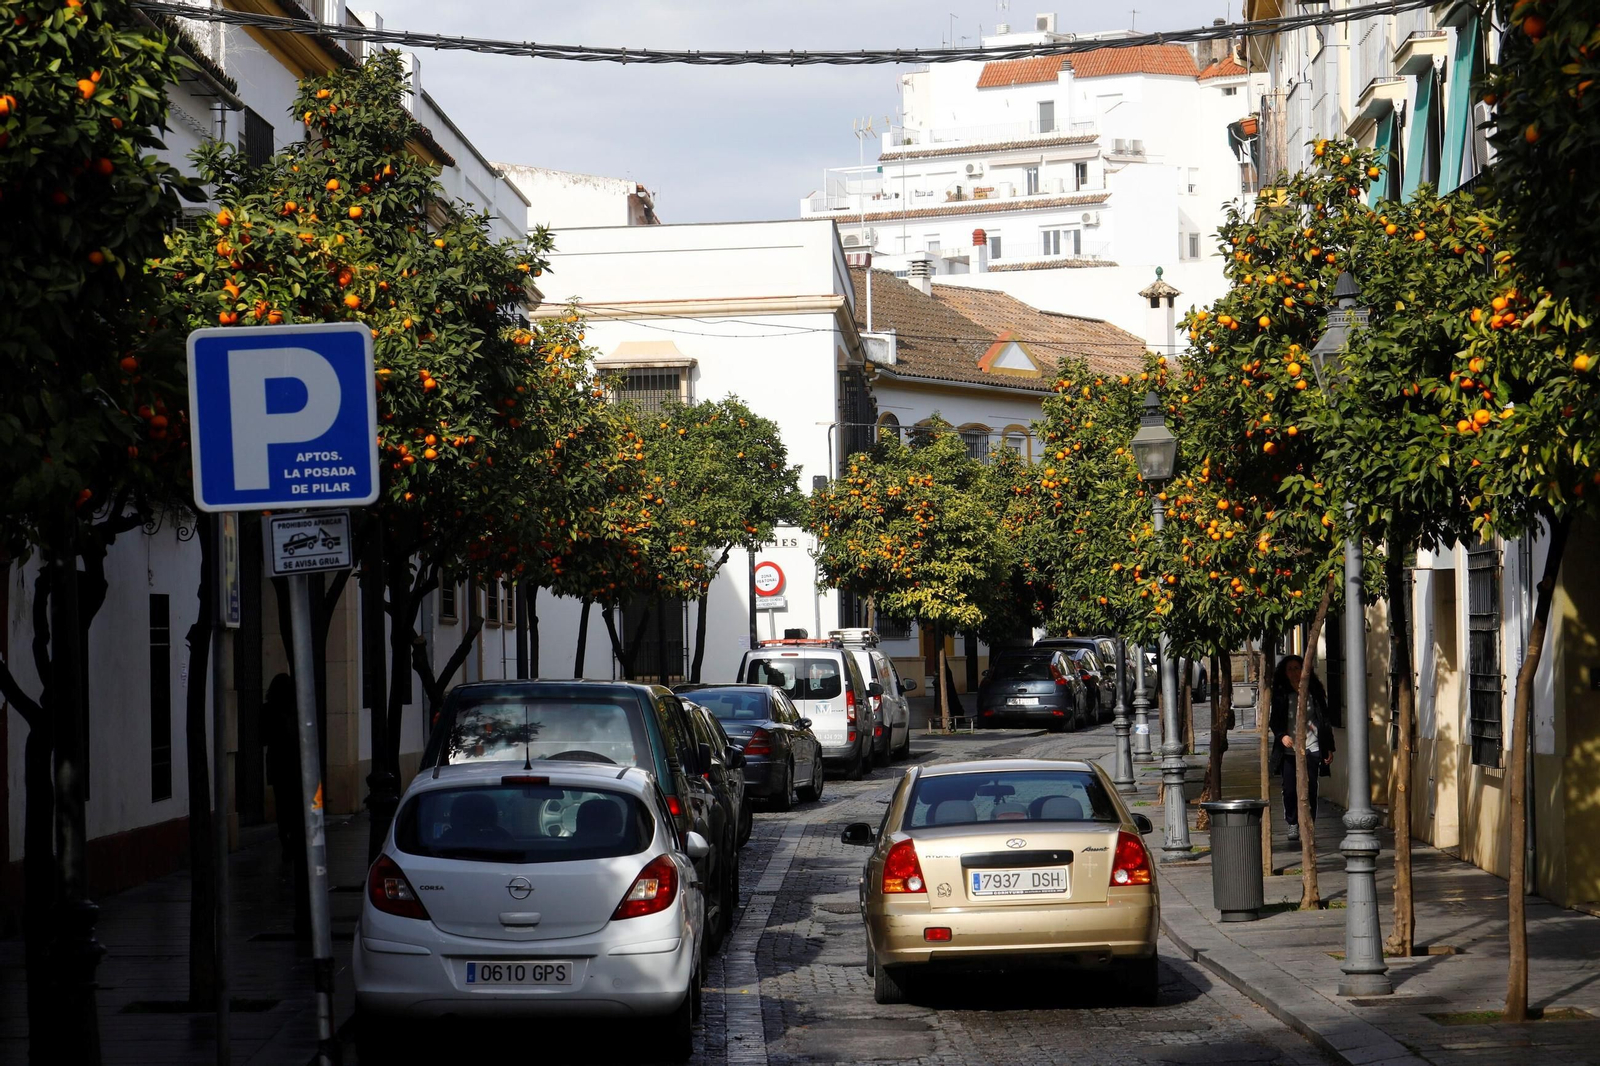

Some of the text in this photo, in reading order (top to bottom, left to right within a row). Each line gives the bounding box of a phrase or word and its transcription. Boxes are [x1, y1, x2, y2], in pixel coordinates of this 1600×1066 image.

[227, 347, 342, 491] P
[296, 451, 342, 462] APTOS.
[284, 466, 356, 479] LA POSADA
[291, 482, 350, 494] DE PILAR
[277, 518, 342, 530] PROHIBIDO APARCAR
[283, 557, 340, 569] SE AVISA GRUA
[983, 872, 1059, 888] 7937 DSH
[481, 965, 525, 981] 0610
[533, 964, 566, 981] GPS
